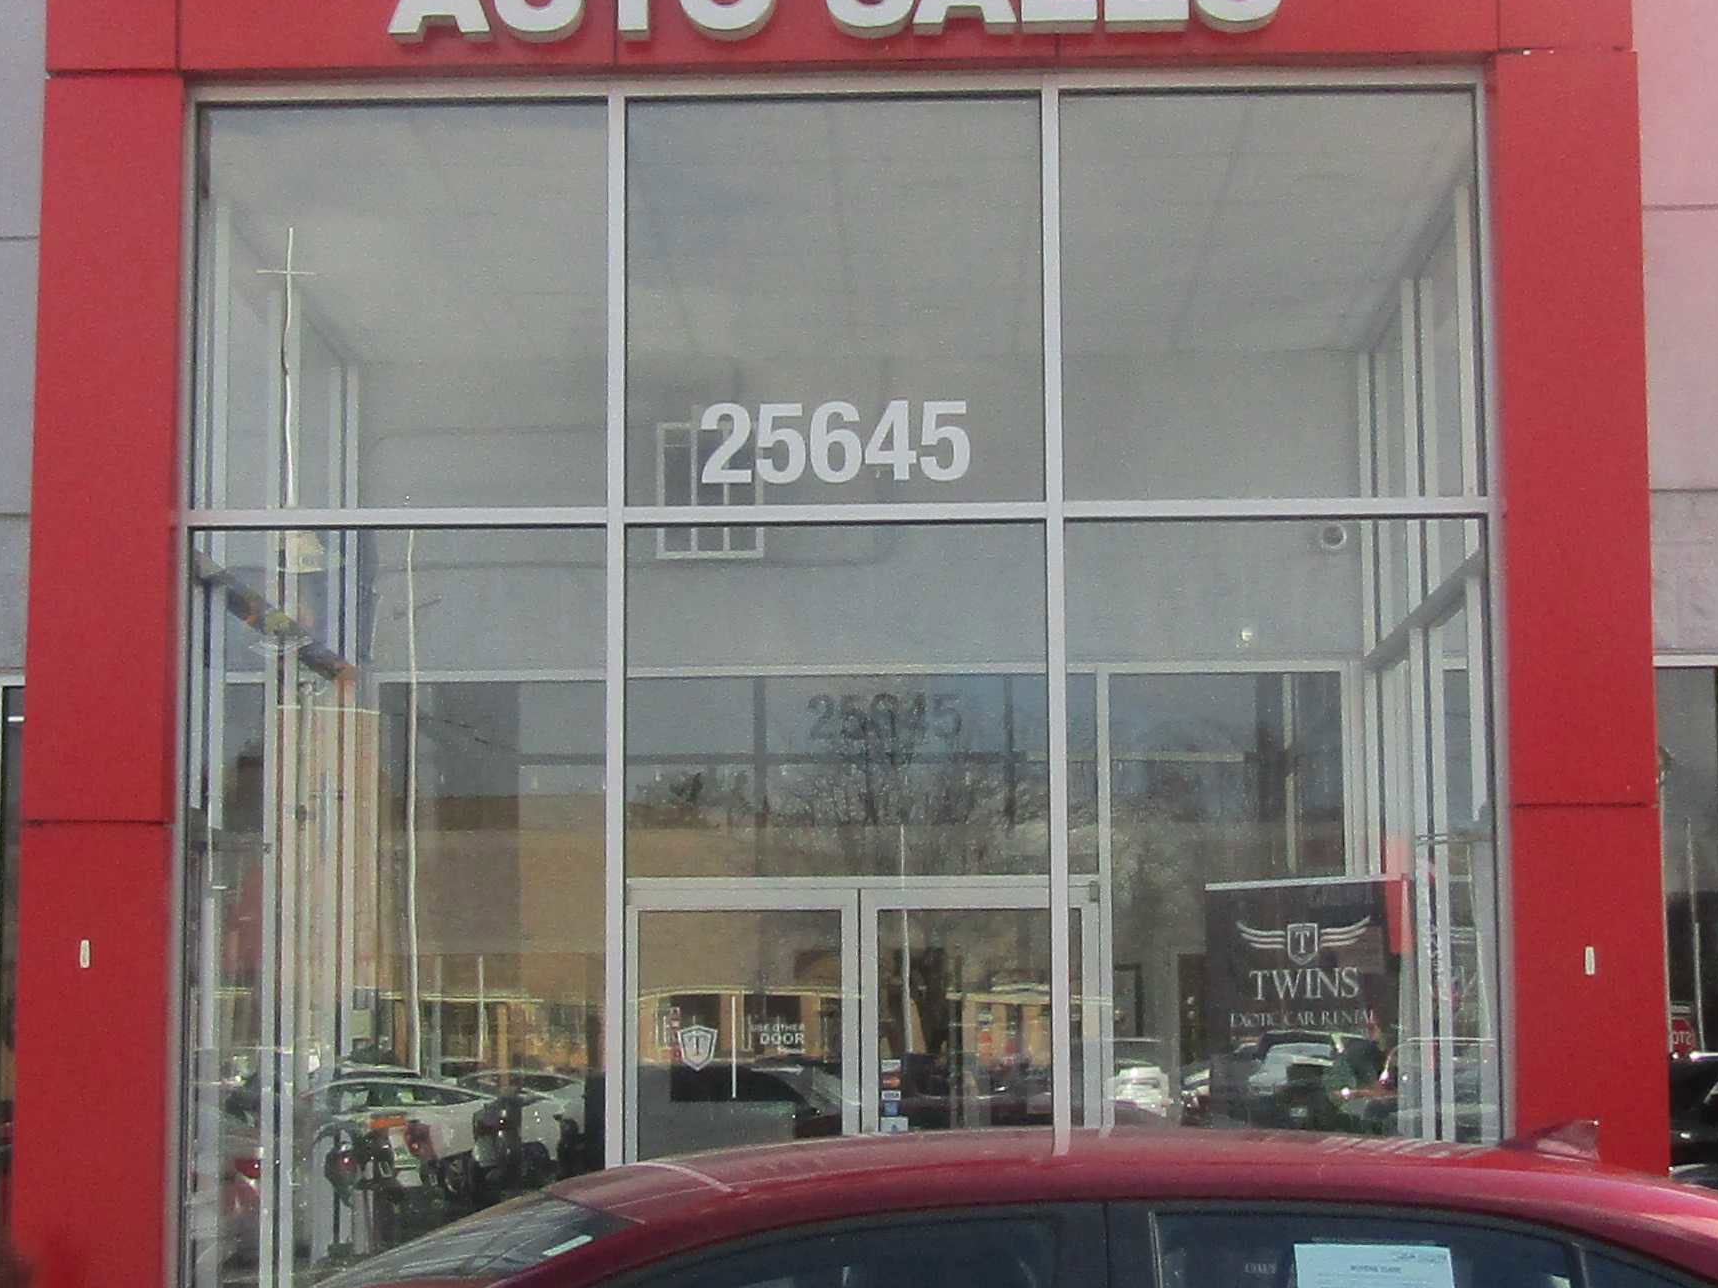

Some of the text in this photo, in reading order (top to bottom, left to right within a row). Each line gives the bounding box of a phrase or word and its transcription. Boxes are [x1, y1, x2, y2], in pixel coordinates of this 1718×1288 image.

[700, 400, 971, 484] 25645
[1294, 930, 1311, 954] T
[1249, 966, 1360, 1001] TWINS
[759, 1032, 805, 1045] DOOR
